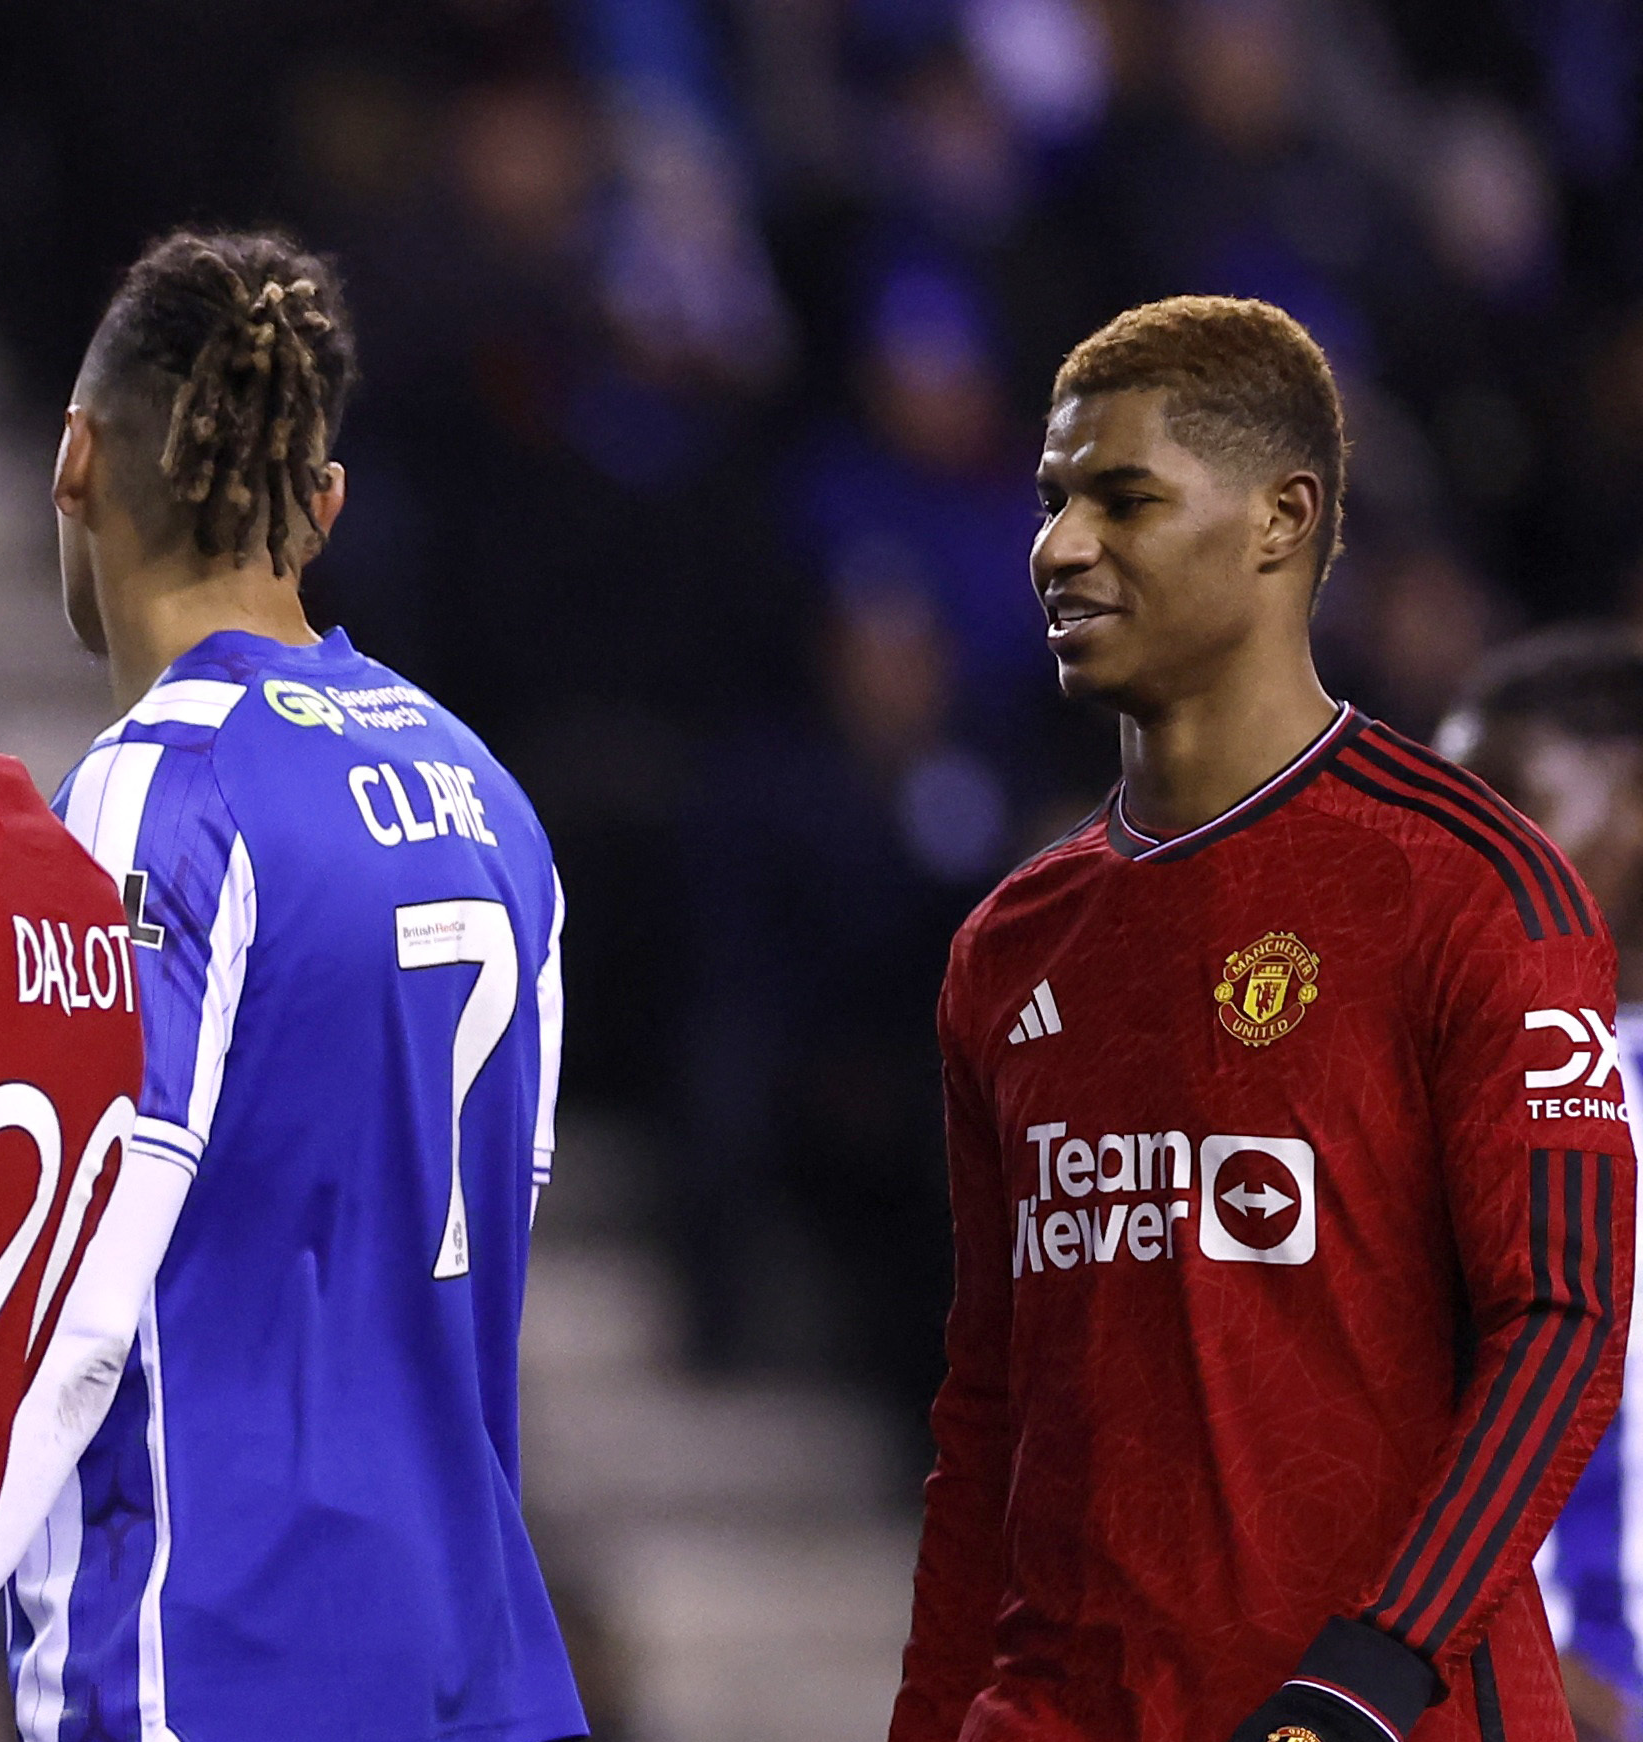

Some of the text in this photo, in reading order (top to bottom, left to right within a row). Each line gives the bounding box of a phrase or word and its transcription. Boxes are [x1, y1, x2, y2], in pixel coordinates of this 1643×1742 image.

[349, 763, 498, 847] CLARE
[12, 914, 136, 1016] DALOT
[1232, 940, 1313, 977] MANCHESTER
[1232, 1018, 1288, 1038] UNITED
[1525, 1008, 1619, 1088] DX
[395, 899, 519, 1280] 7
[1527, 1098, 1628, 1123] TECHNO
[1027, 1121, 1192, 1201] Team
